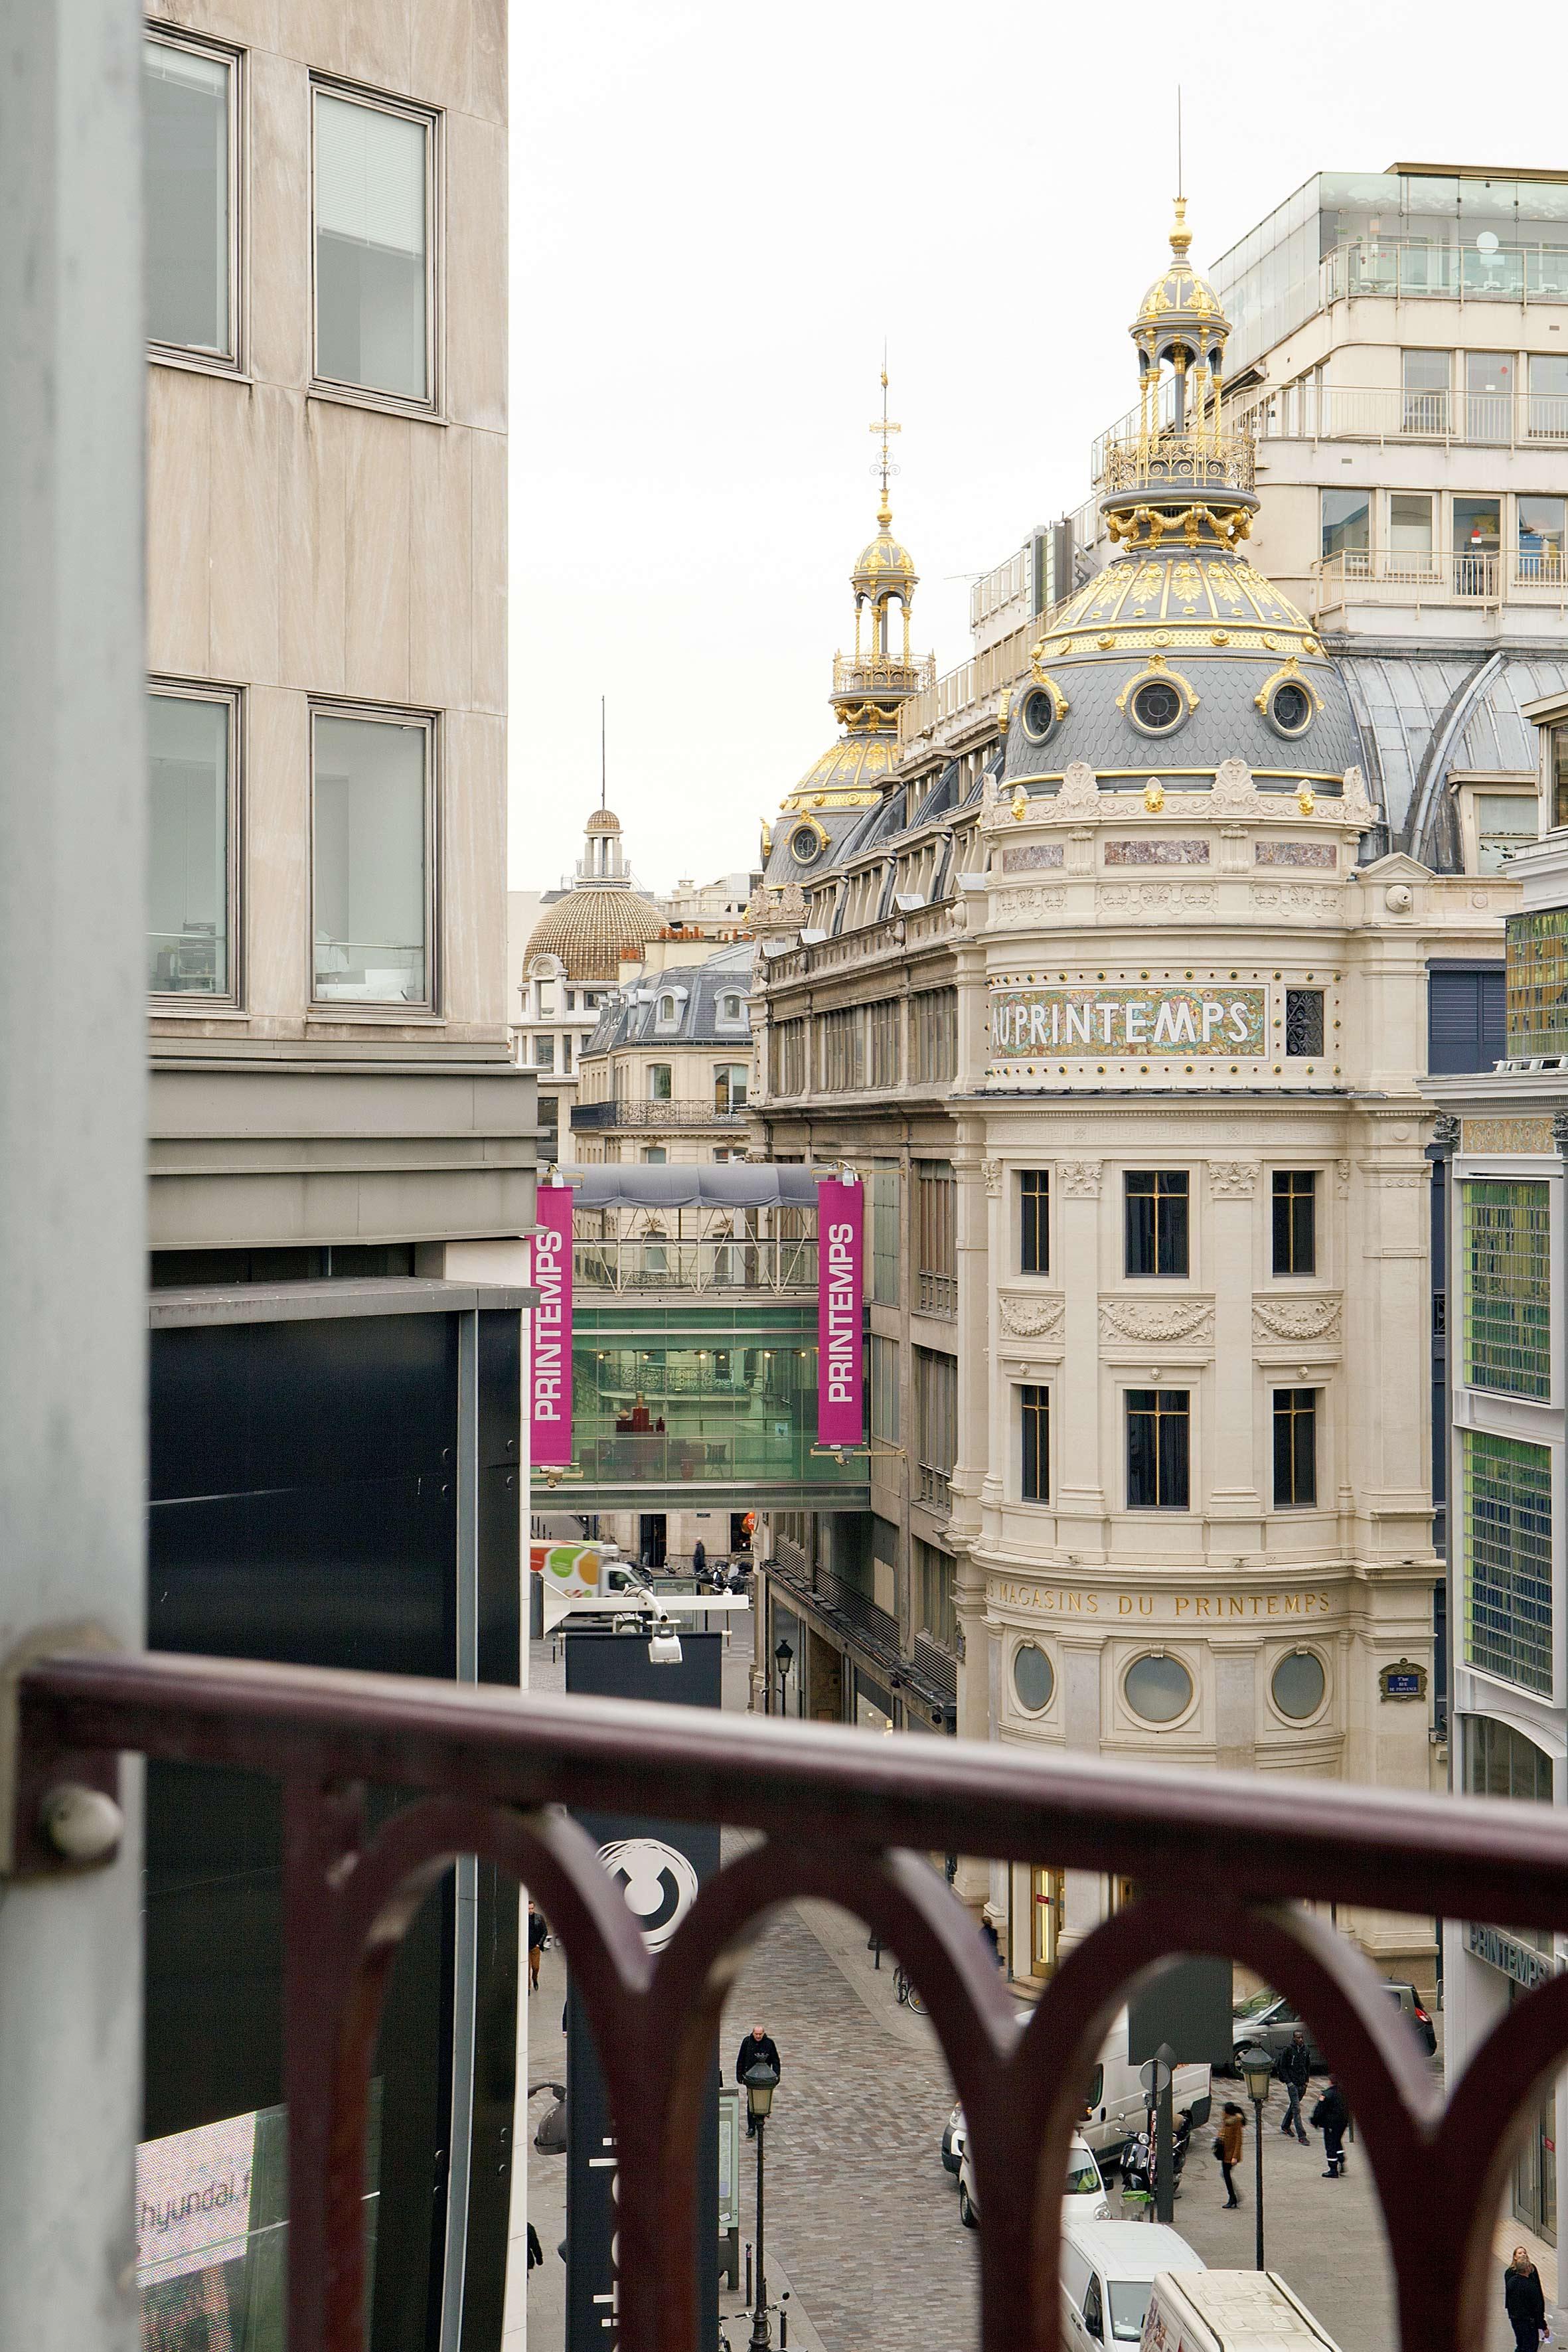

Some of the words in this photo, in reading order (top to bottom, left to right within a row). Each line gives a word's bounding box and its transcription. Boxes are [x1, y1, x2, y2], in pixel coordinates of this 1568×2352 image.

[1015, 1002, 1249, 1045] PRINTEMPS
[535, 1223, 562, 1420] PRINTEMPS
[828, 1223, 853, 1402] PRINTEMPS
[999, 1582, 1099, 1612] MAGASINS
[1117, 1595, 1153, 1615] DU
[1174, 1593, 1329, 1616] PRINTEMPS
